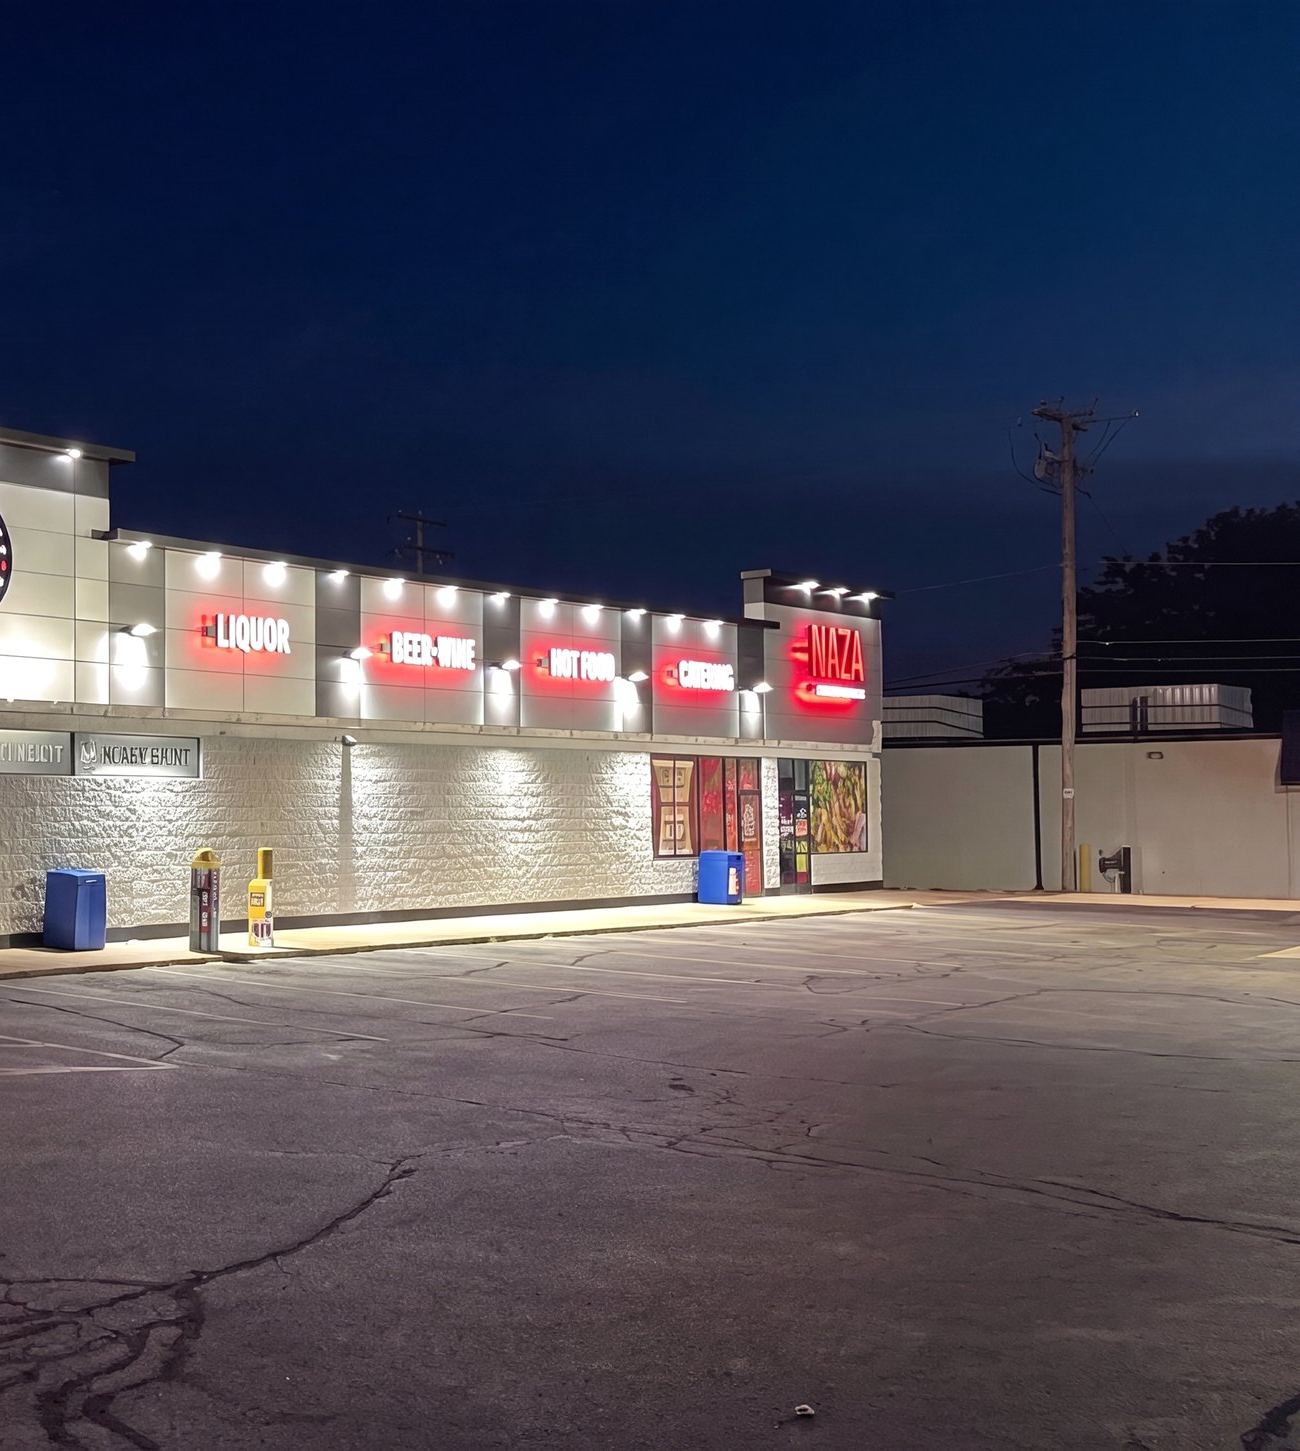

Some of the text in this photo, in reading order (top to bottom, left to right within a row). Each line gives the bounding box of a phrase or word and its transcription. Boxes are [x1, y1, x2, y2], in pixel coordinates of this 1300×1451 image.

[216, 613, 291, 654] LIQUOR
[811, 624, 864, 682] NAZA
[550, 648, 580, 679] HOT
